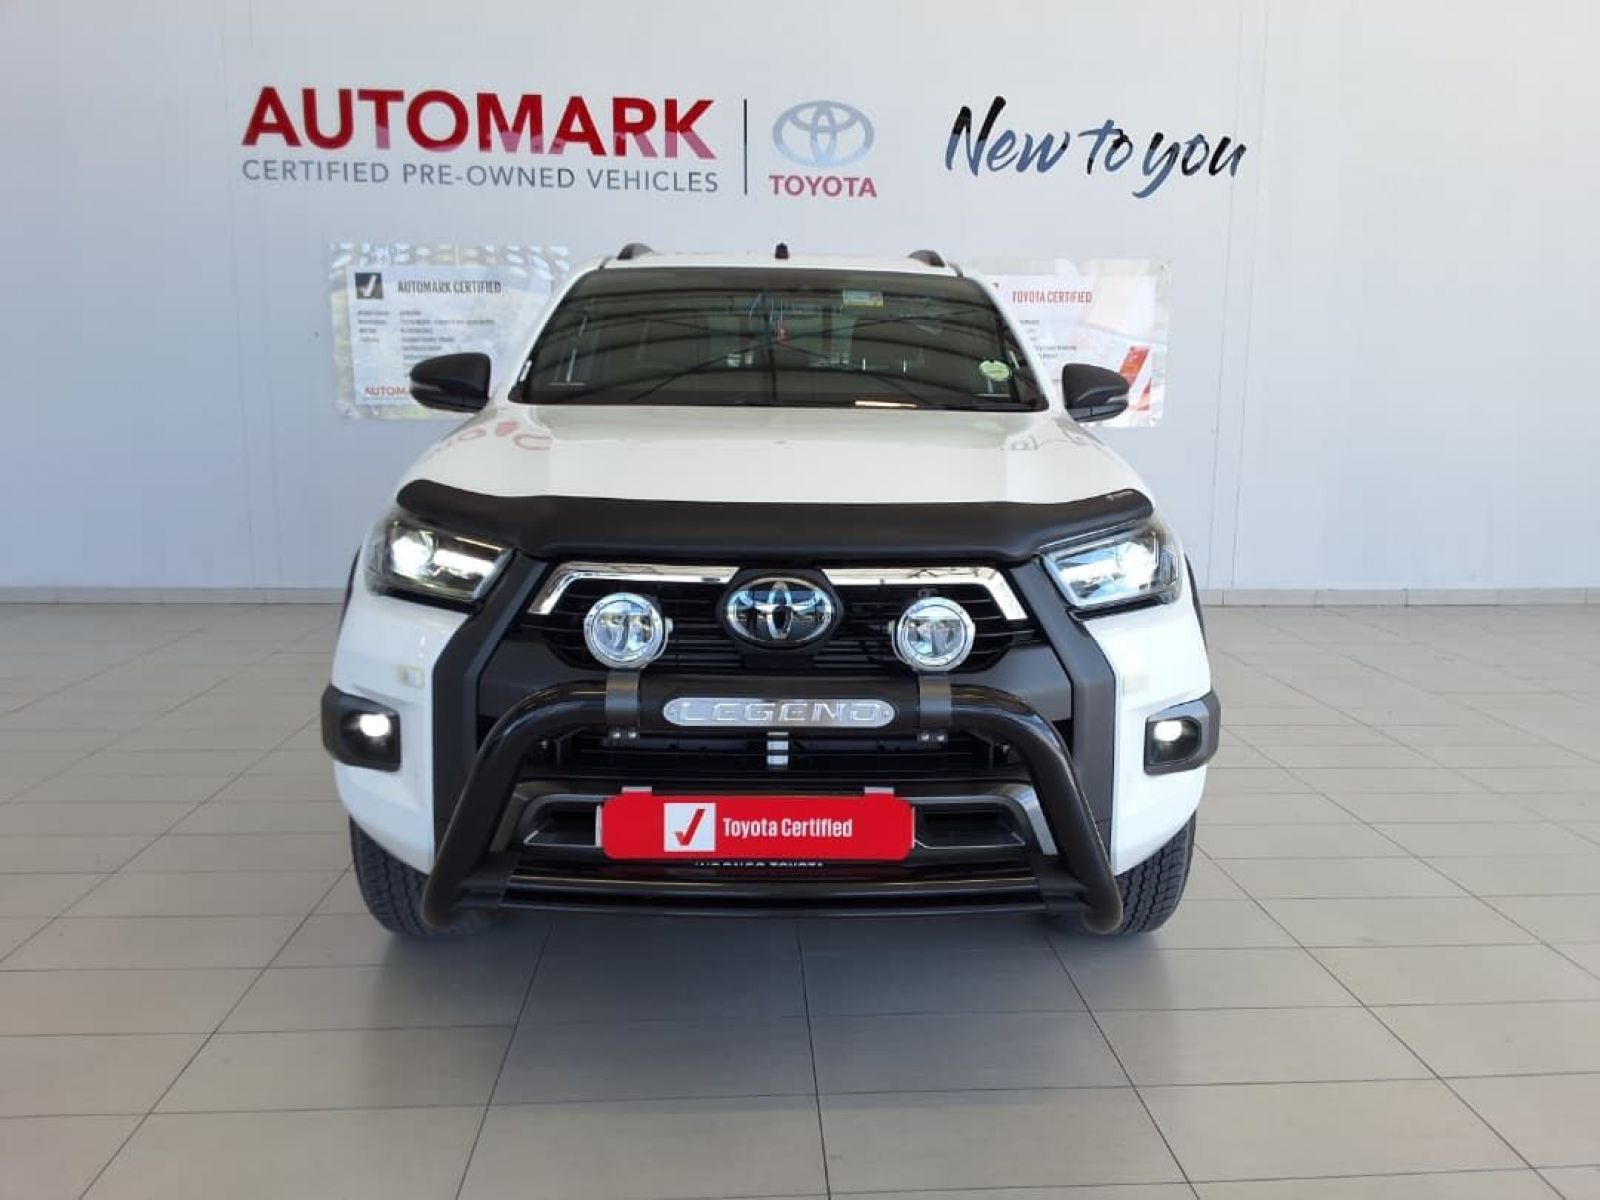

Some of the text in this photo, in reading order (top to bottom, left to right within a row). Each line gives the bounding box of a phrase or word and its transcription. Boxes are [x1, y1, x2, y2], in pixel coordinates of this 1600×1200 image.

[242, 86, 716, 160] AUTOMARK
[945, 95, 1247, 198] New to you
[242, 159, 718, 193] CERTIFIED PRE-OWNED VEHICLES
[769, 174, 877, 198] TOYOTA
[398, 280, 501, 295] AUTOMARK CERTIFIED
[1012, 290, 1093, 304] TOYOTA CERTIFIED
[681, 702, 881, 722] LEGEND
[723, 817, 853, 838] Toyota Certified
